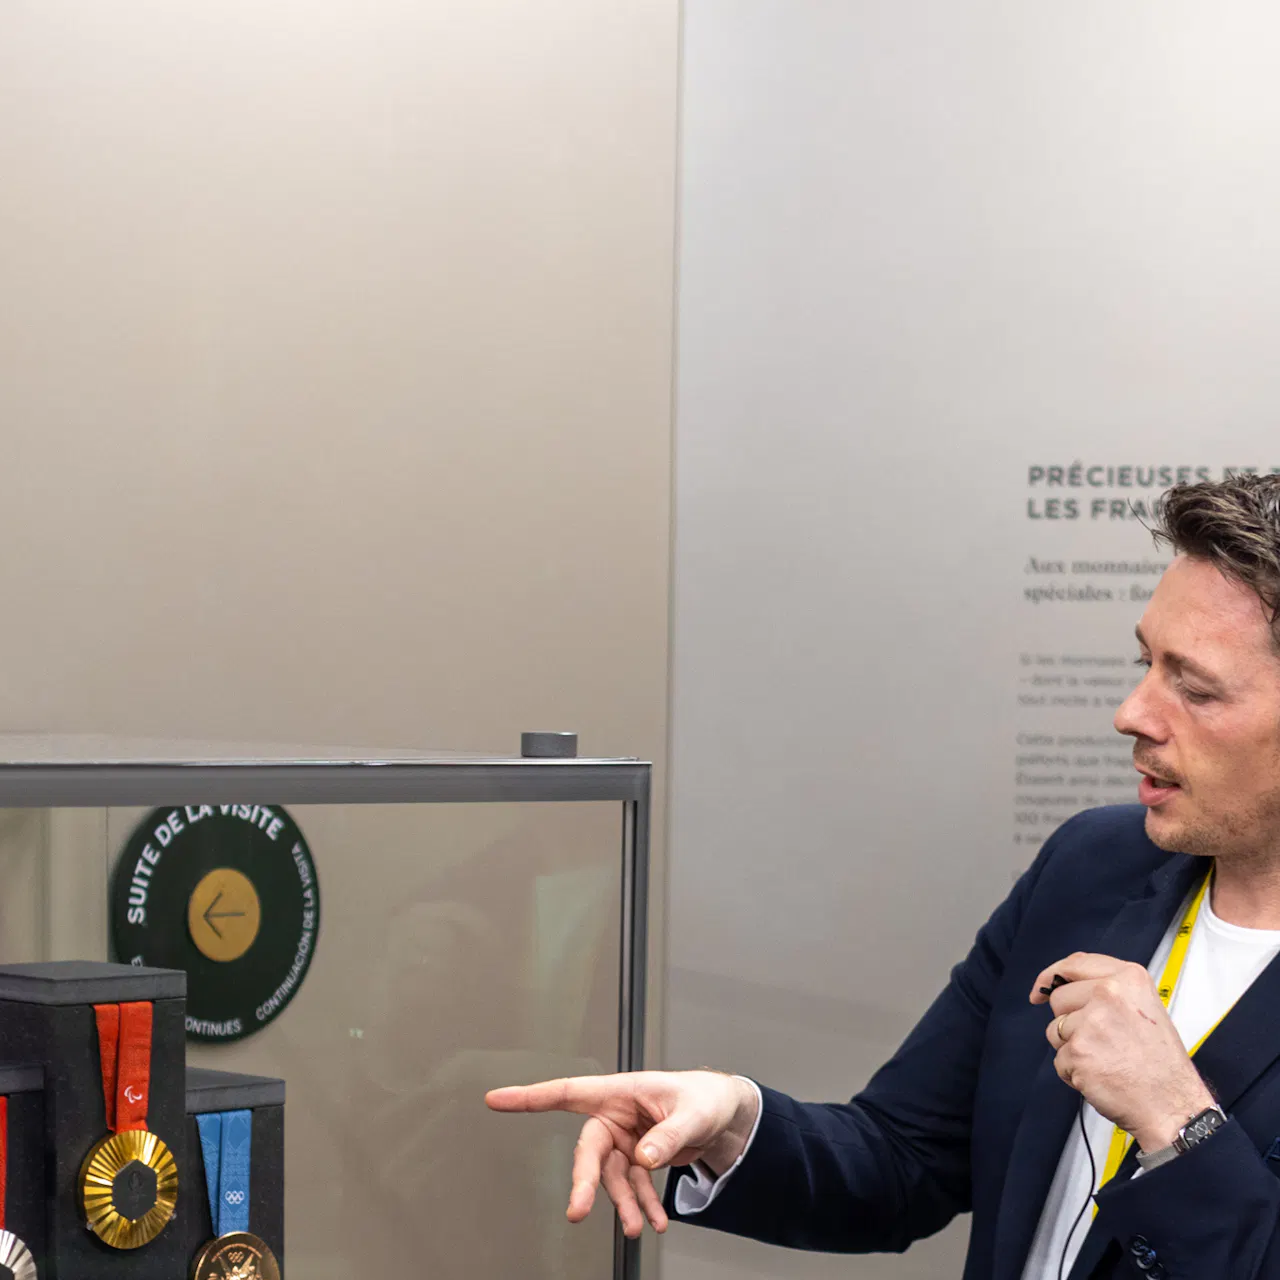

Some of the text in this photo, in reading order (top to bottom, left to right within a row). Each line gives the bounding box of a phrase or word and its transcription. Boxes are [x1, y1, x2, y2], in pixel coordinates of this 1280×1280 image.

[1028, 460, 1211, 487] PRÉCIEUSES
[1027, 498, 1080, 520] LES
[127, 804, 284, 924] SUITE DE LA VISITE
[303, 888, 314, 907] LA
[303, 911, 314, 929] DE
[255, 931, 312, 1021] CONTINUACIÓN
[185, 1016, 242, 1036] ONTINUES
